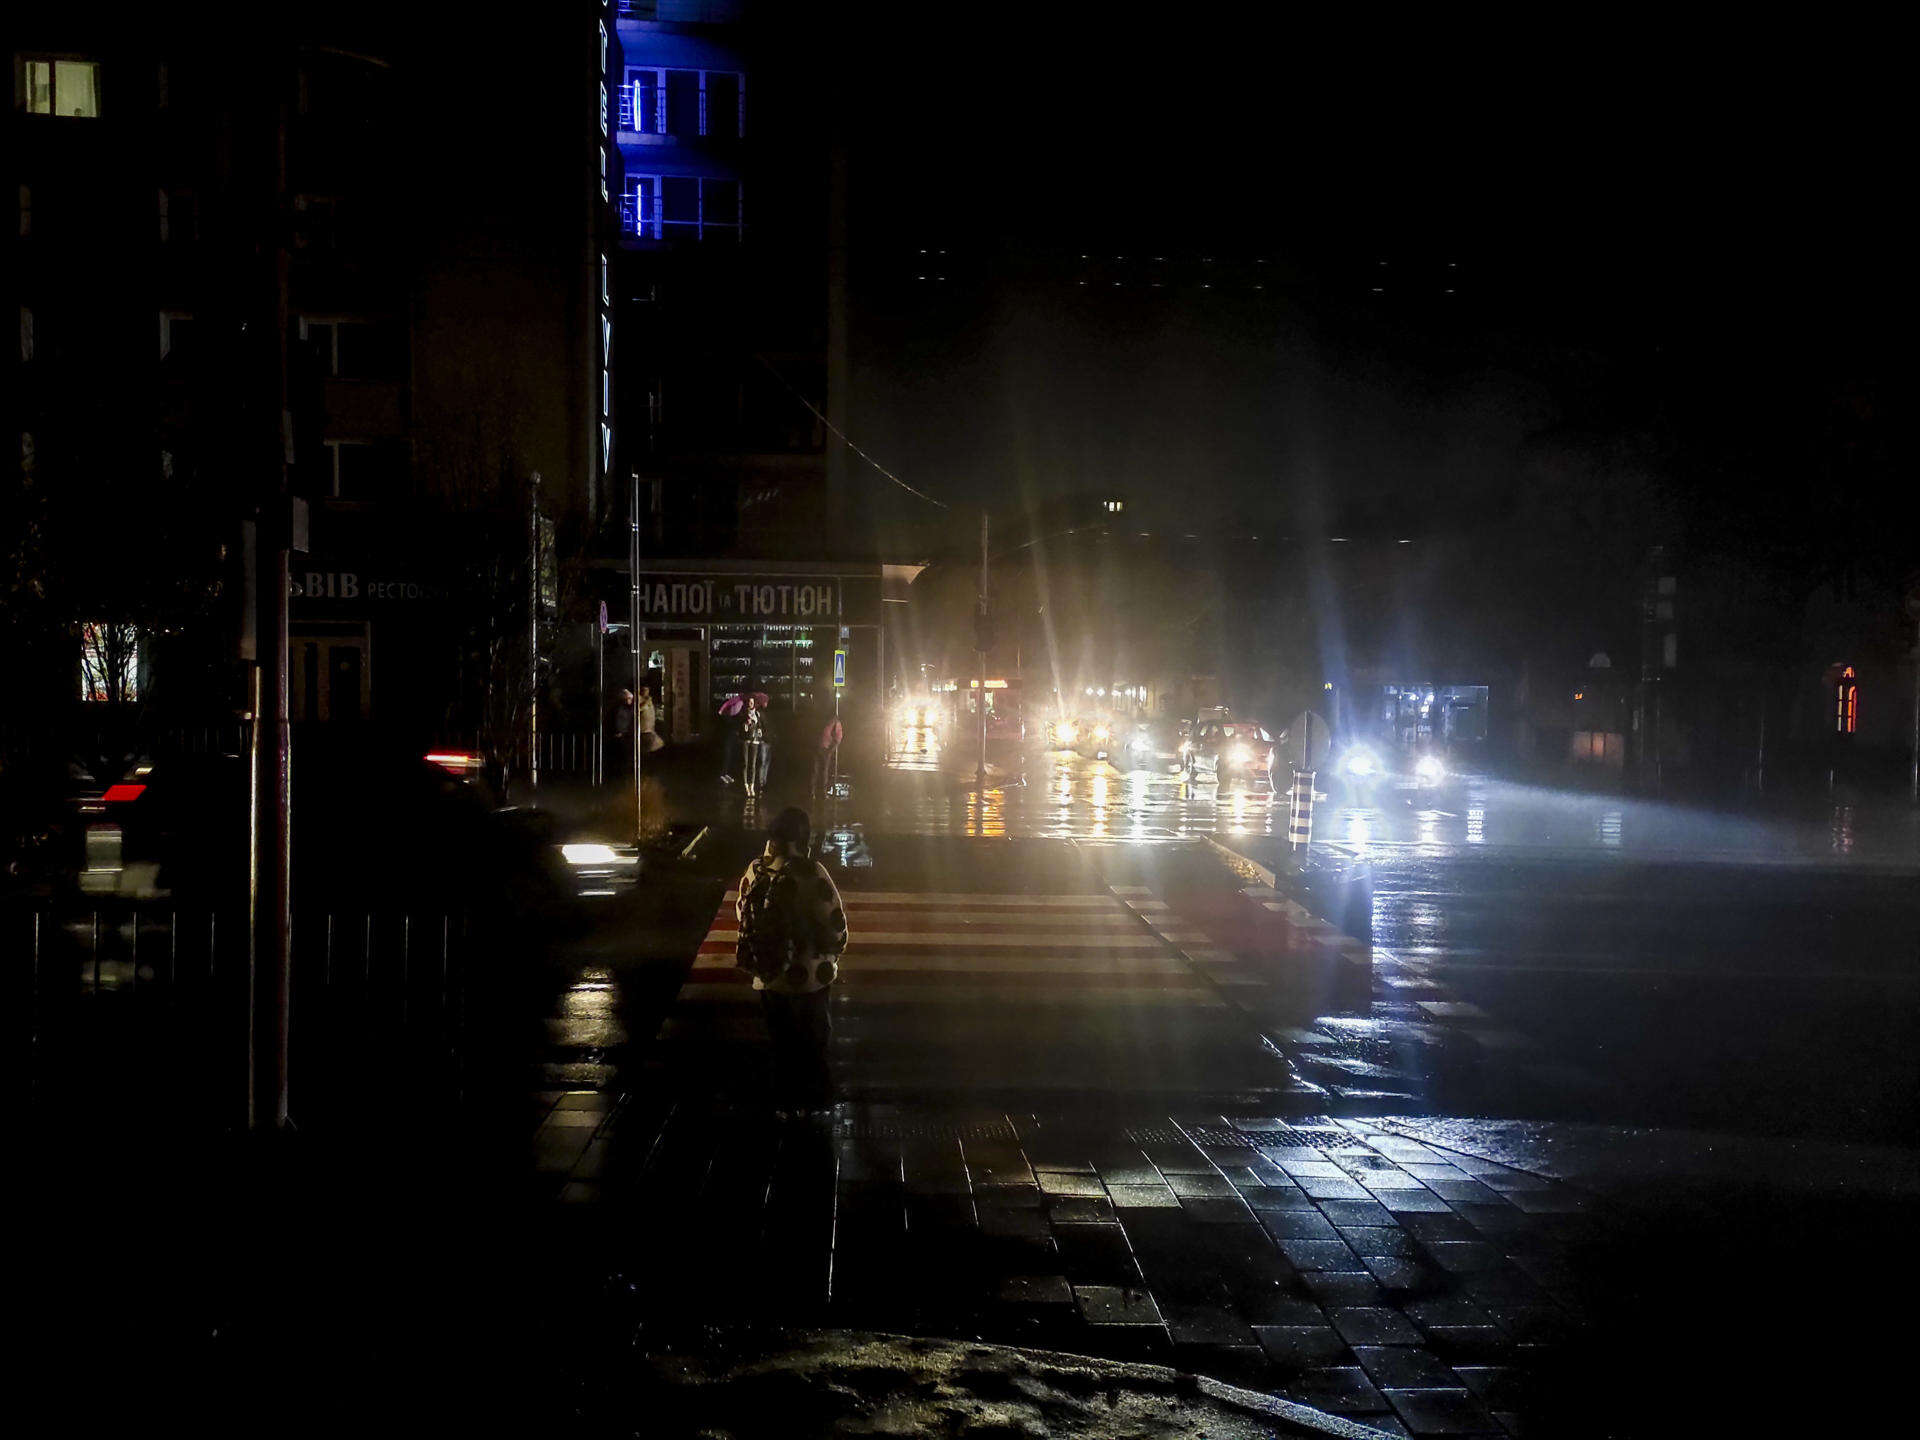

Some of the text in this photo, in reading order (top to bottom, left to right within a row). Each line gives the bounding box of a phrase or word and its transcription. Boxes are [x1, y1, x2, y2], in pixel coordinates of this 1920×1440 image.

[599, 0, 611, 475] TEL LVIV
[734, 584, 832, 615] ТЮТЮН
